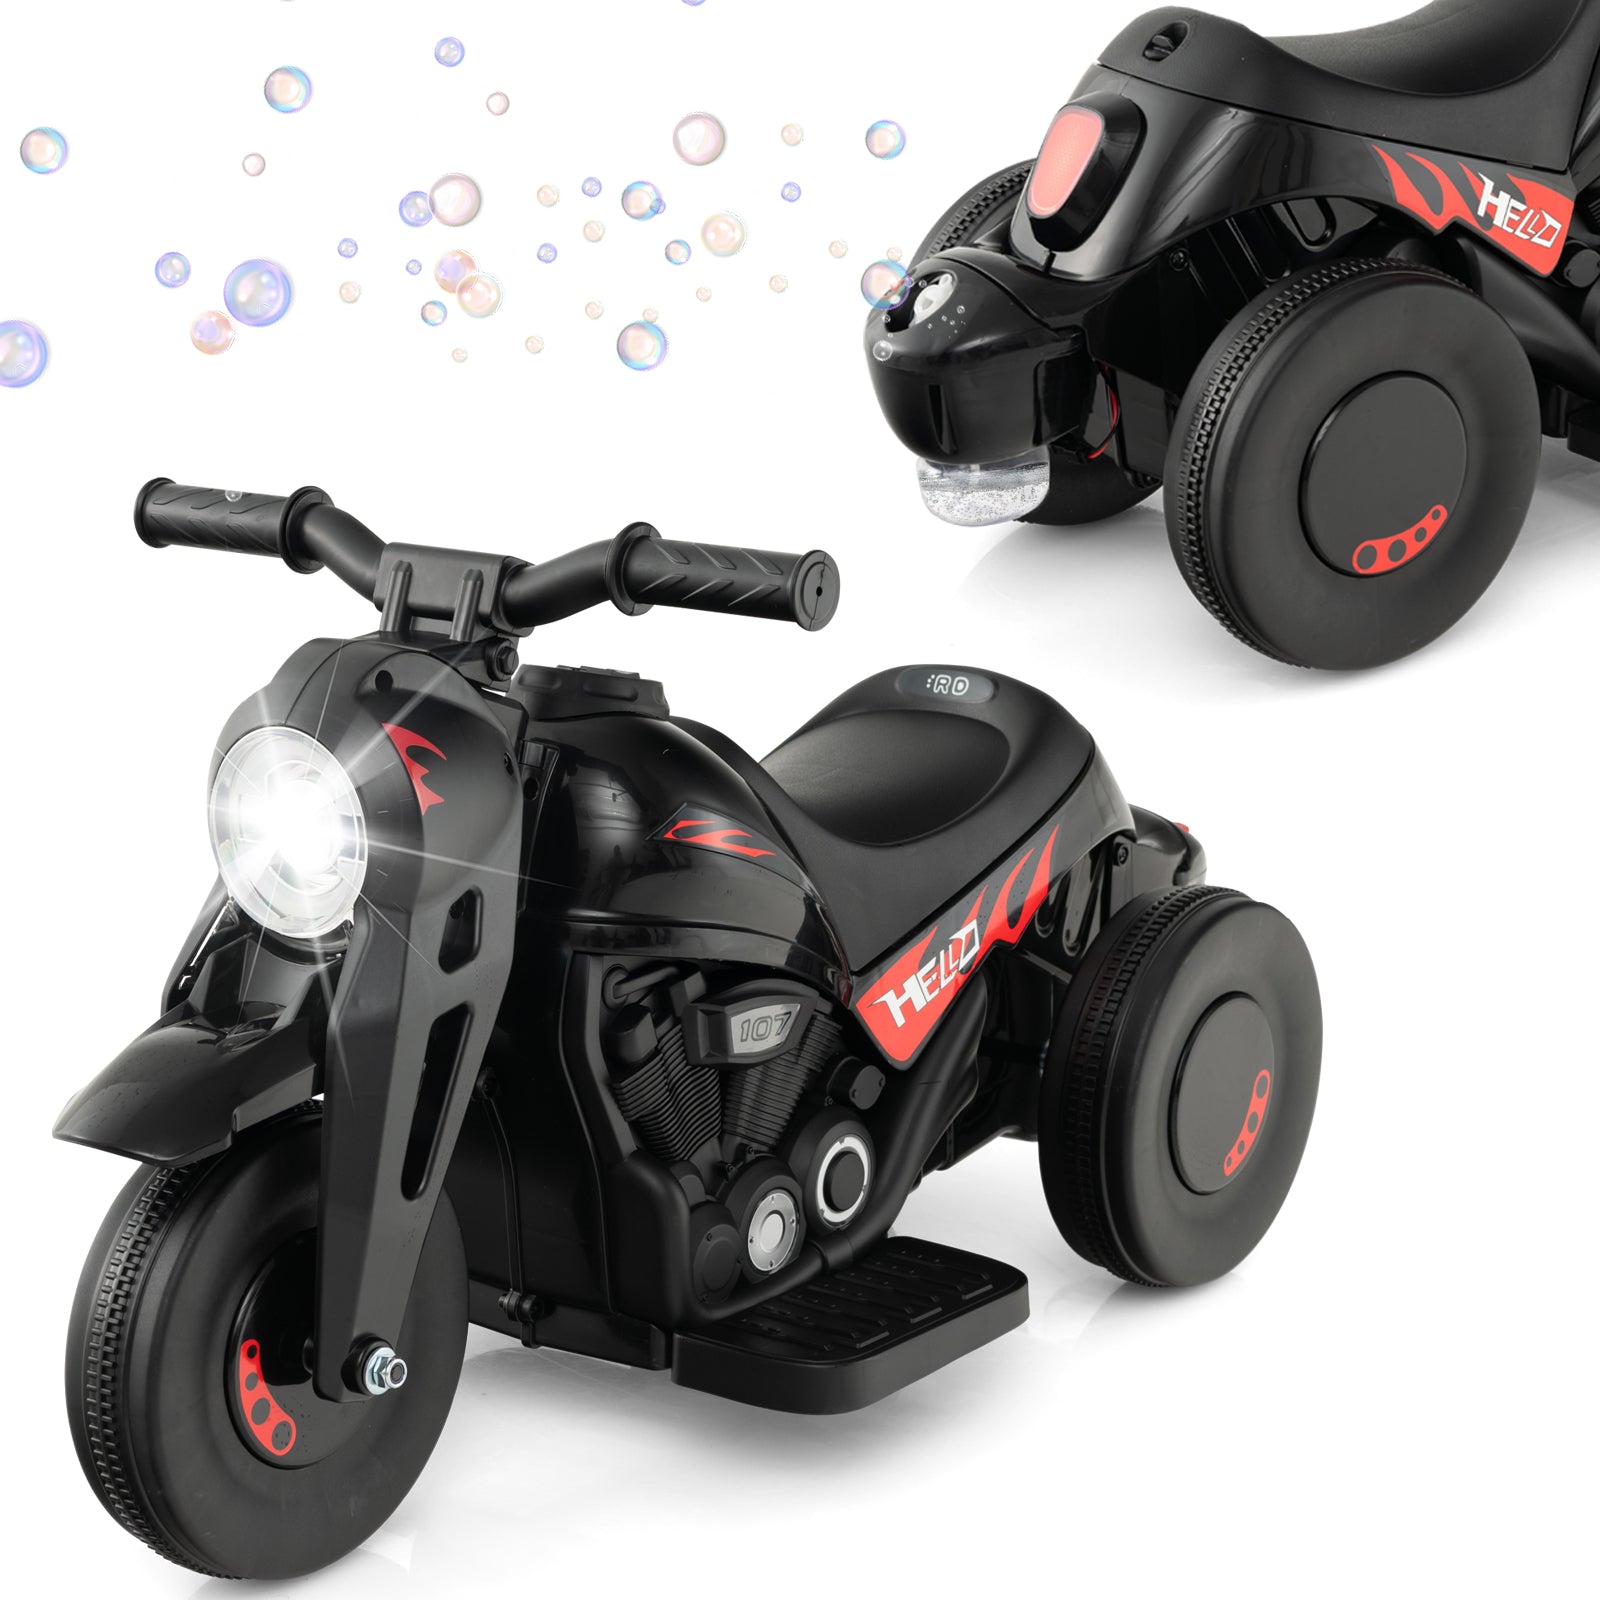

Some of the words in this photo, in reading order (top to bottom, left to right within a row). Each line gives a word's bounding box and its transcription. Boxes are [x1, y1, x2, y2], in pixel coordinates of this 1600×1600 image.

[1477, 171, 1562, 249] HELLO
[867, 918, 981, 1028] HELLO
[740, 1011, 792, 1042] 107
